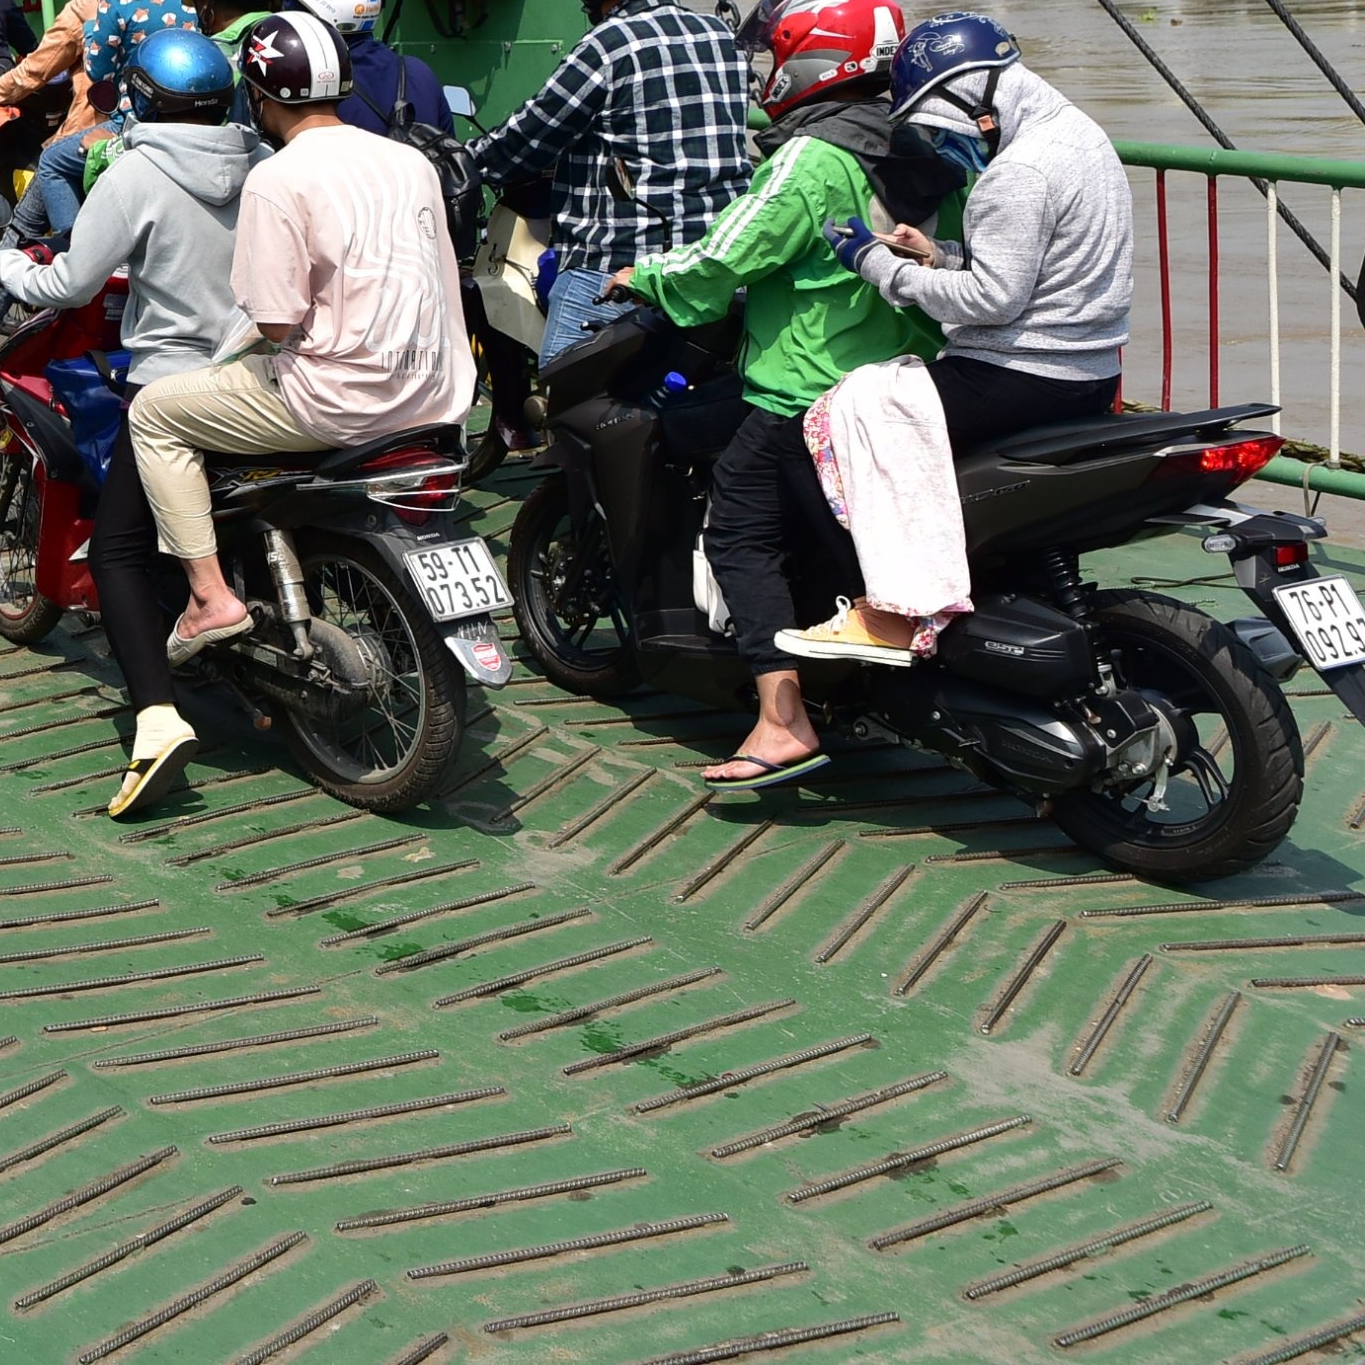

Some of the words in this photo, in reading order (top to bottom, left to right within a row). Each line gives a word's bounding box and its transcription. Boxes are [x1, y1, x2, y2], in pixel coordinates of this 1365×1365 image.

[194, 98, 219, 107] Honda
[417, 545, 481, 581] 59-T1
[427, 575, 506, 615] 073.52
[1288, 583, 1351, 625] 76-P1
